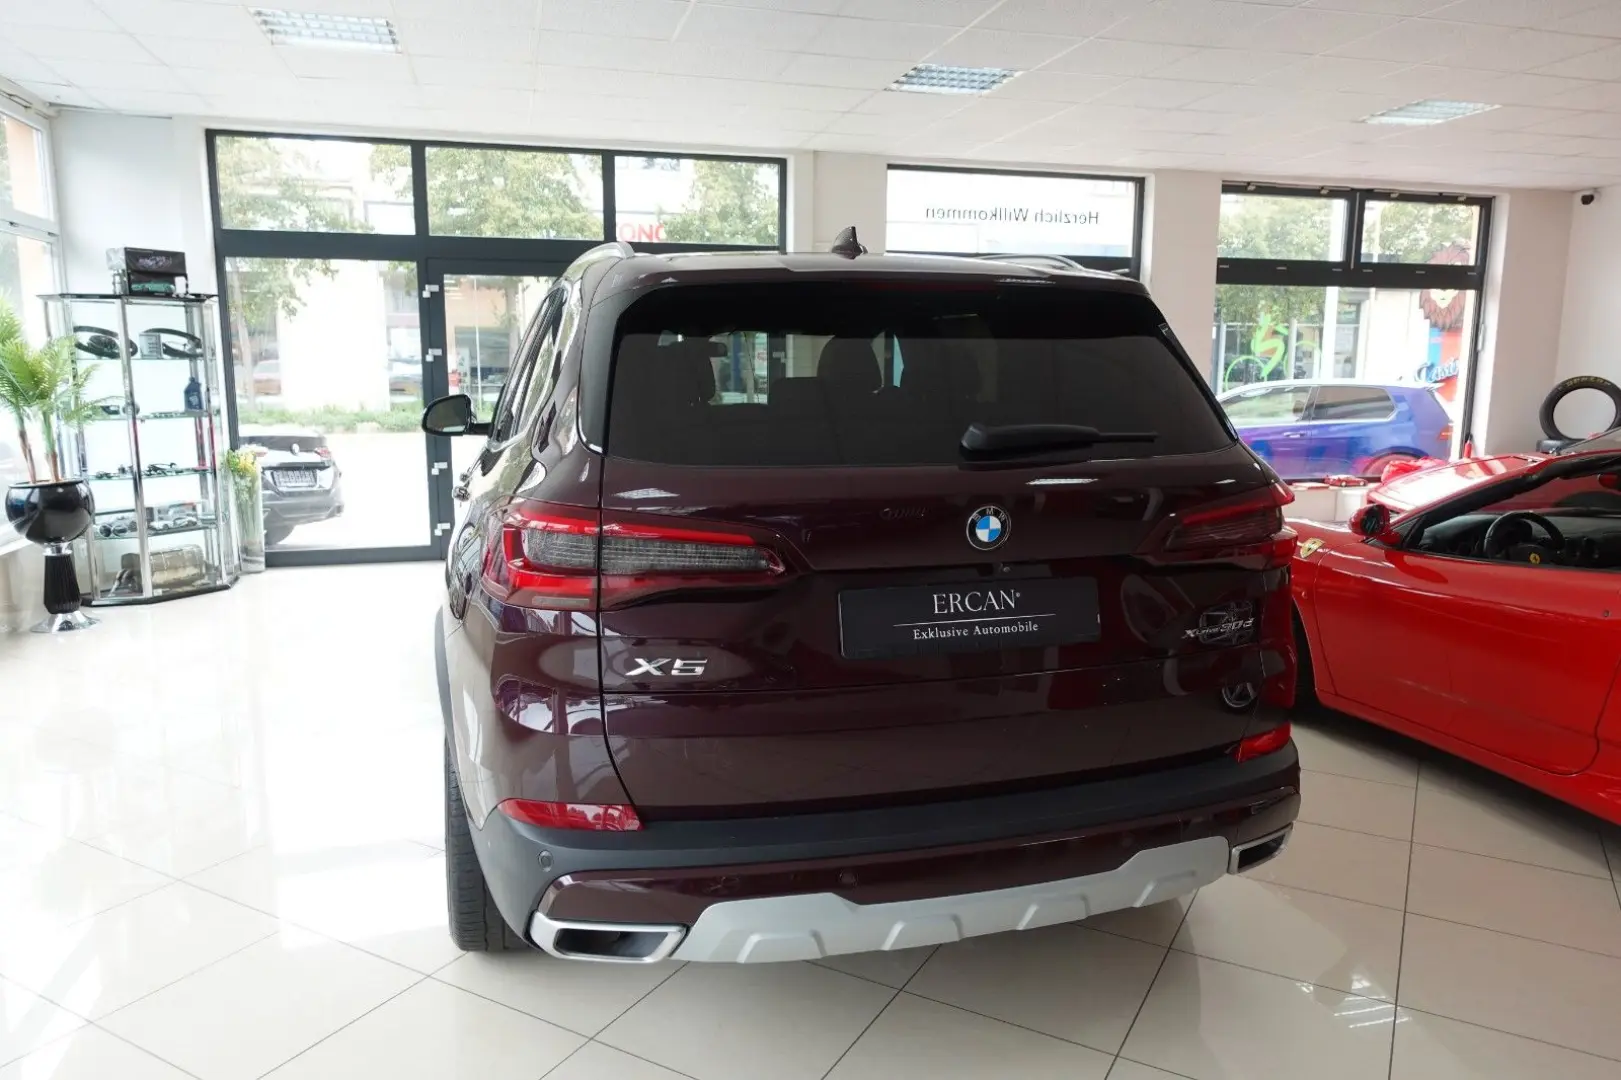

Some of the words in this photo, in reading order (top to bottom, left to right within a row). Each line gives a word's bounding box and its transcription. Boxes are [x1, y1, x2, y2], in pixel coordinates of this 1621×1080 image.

[912, 626, 969, 640] Exklusive
[972, 620, 1039, 636] Automobile
[625, 657, 708, 677] X5
